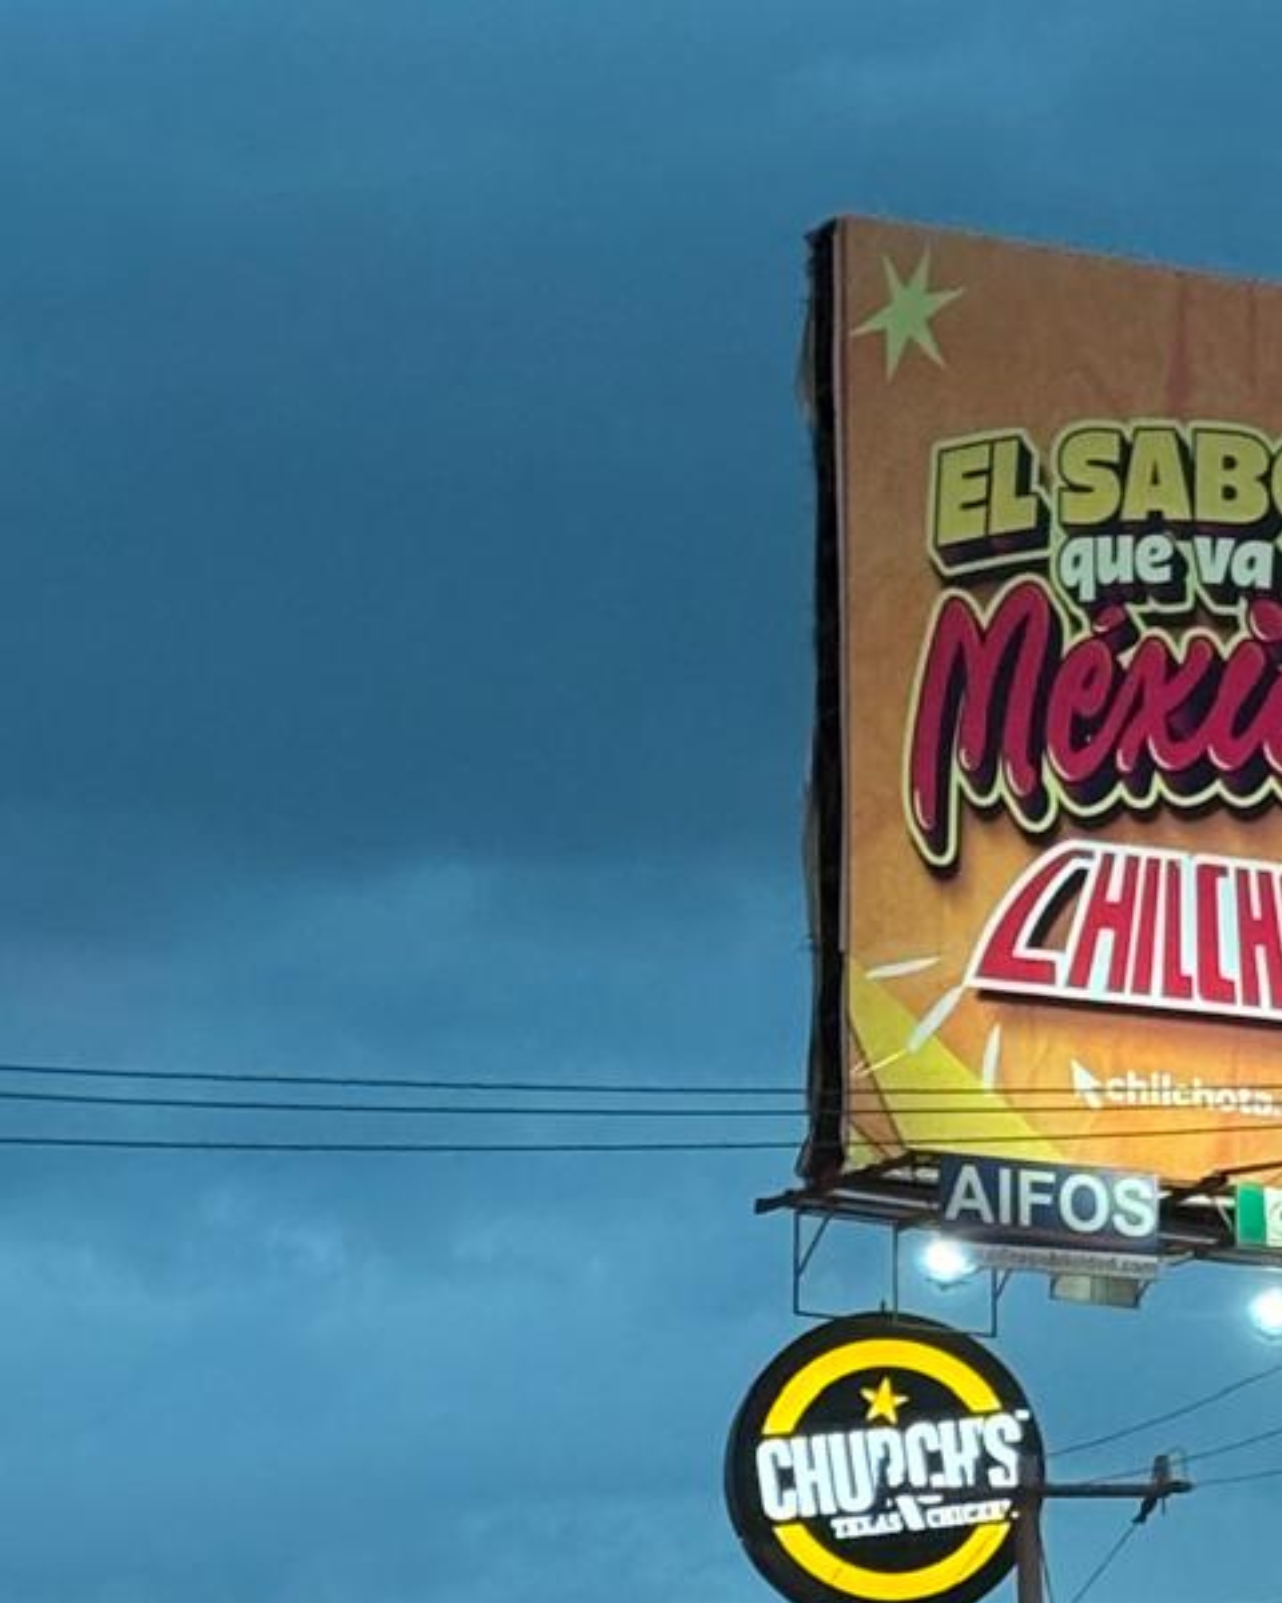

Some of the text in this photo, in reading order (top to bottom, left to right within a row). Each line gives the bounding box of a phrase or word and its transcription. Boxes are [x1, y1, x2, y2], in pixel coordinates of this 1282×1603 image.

[935, 434, 1044, 550] EL
[1058, 531, 1179, 603] que
[1194, 535, 1276, 592] va
[945, 1163, 1157, 1239] AIFOS
